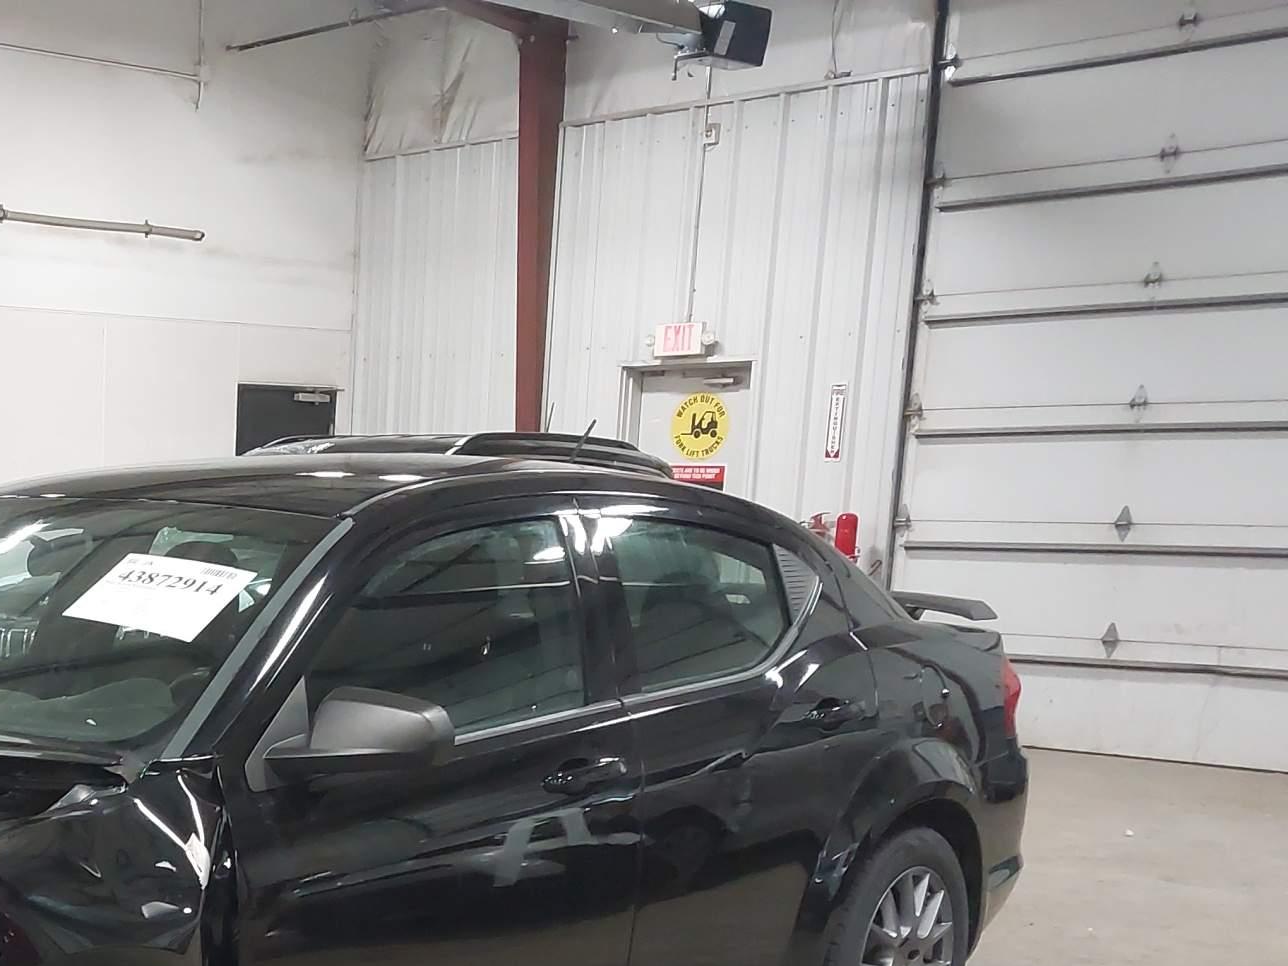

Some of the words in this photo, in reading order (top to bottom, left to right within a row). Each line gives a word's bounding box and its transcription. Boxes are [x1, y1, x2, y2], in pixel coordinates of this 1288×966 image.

[663, 324, 694, 352] EXIT
[676, 395, 699, 418] WATCH
[700, 394, 715, 405] OUT
[713, 402, 726, 418] FOR
[674, 434, 687, 451] FORK
[685, 448, 700, 458] LIFT
[701, 435, 724, 457] TRUCKS
[118, 569, 223, 596] 43872914
